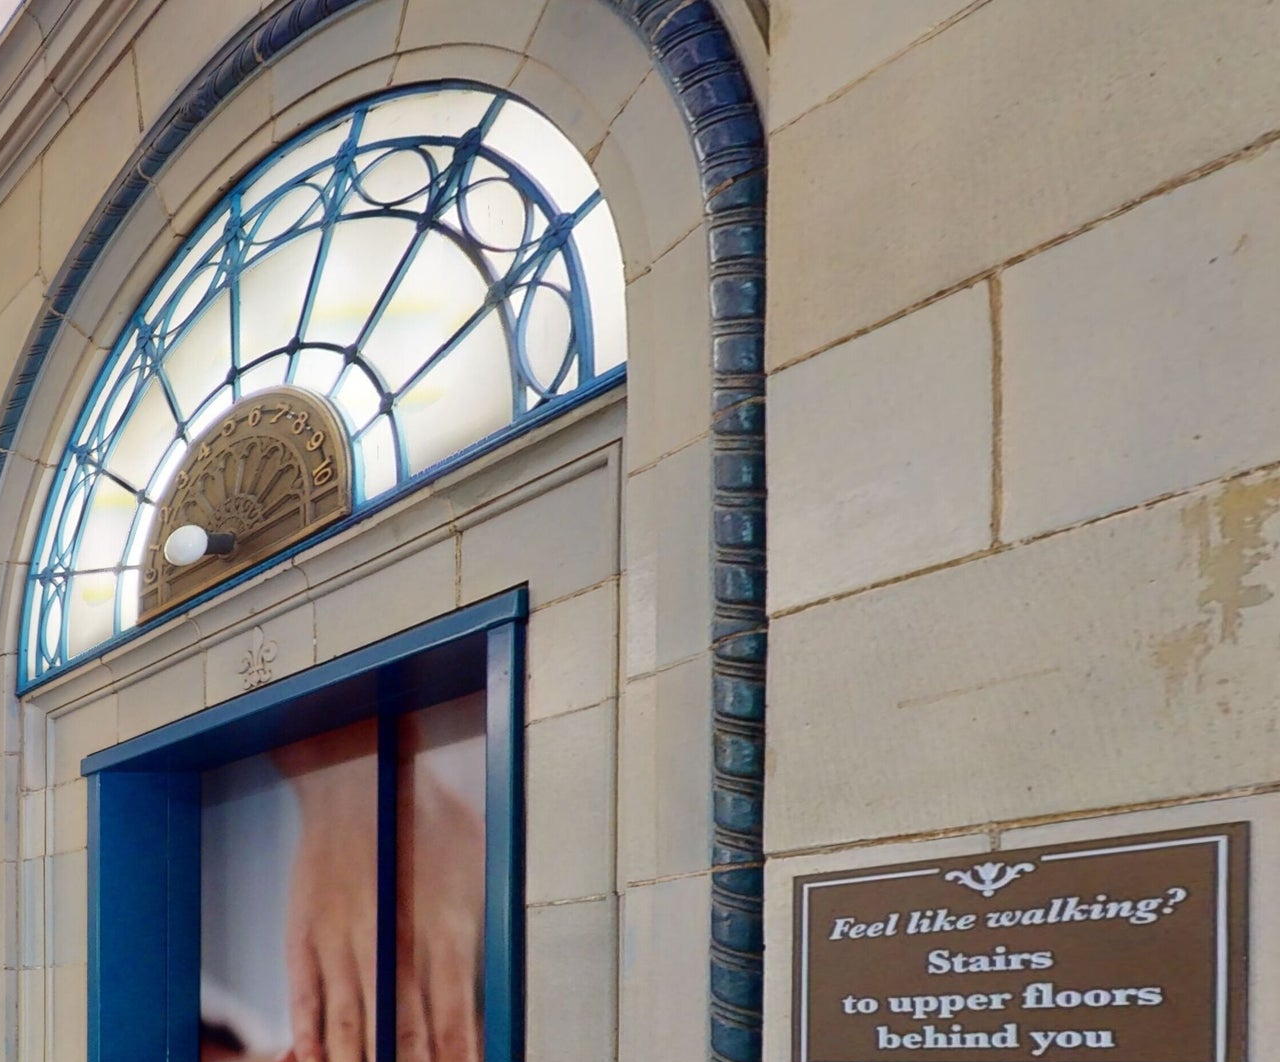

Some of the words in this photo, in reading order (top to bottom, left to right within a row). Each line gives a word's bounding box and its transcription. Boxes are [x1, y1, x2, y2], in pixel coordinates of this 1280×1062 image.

[248, 404, 265, 427] 6
[270, 402, 290, 424] 7
[292, 411, 309, 435] 8
[221, 416, 237, 437] 5
[197, 443, 212, 461] 4
[306, 431, 324, 452] 9
[176, 470, 189, 489] 3
[312, 456, 333, 486] 10
[829, 911, 898, 940] Feel
[906, 909, 976, 935] like
[987, 887, 1187, 925] walking?
[928, 946, 1053, 974] Stairs
[842, 993, 878, 1015] to
[888, 992, 1011, 1019] upper
[1021, 983, 1163, 1010] floors
[877, 1024, 1019, 1050] behind
[1031, 1027, 1115, 1055] you
